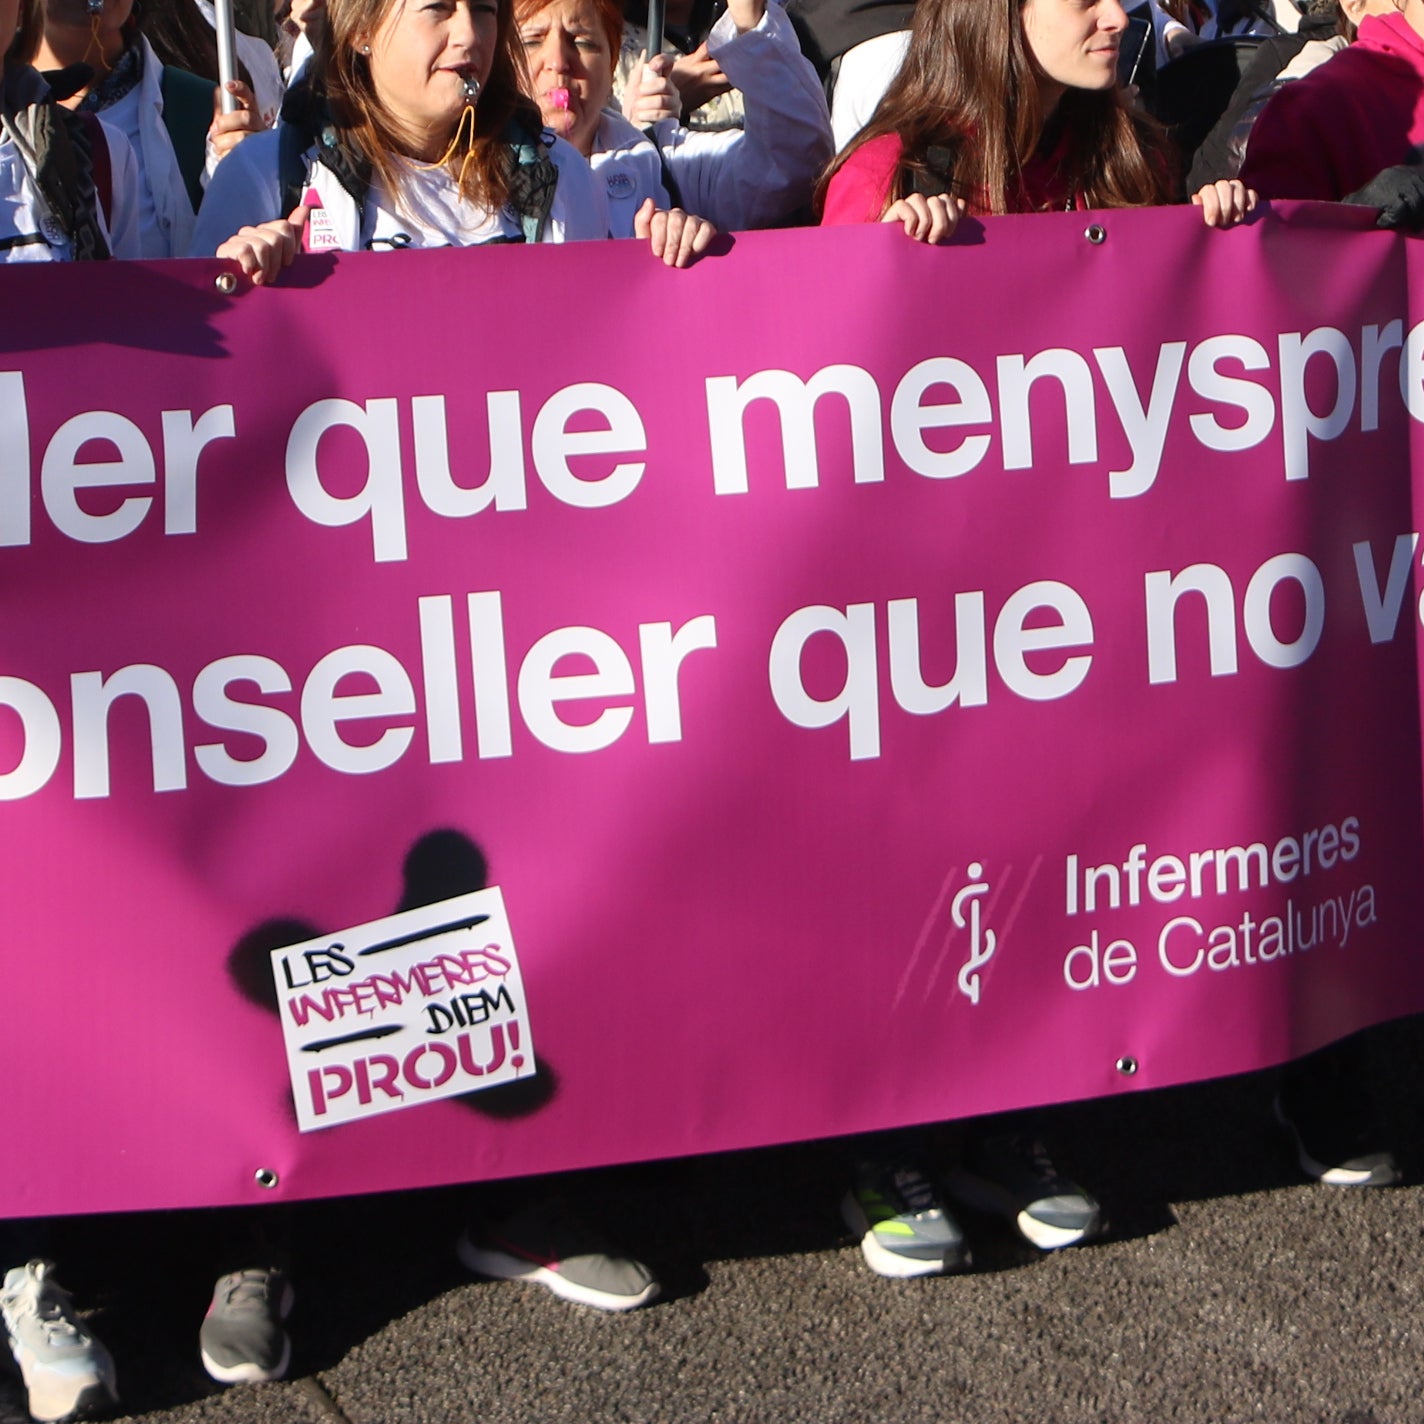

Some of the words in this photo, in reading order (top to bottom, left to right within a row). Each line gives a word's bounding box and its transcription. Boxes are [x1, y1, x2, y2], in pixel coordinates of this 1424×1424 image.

[285, 382, 647, 562] que
[769, 580, 1095, 761] que
[1145, 551, 1325, 684] no
[1065, 815, 1361, 914] Infermeres
[281, 942, 355, 989] LES
[1063, 930, 1137, 990] de
[1157, 876, 1376, 981] Catalunya
[287, 942, 512, 1027] INFERMERES
[424, 983, 516, 1034] DIEM
[307, 1019, 525, 1116] PROU!
